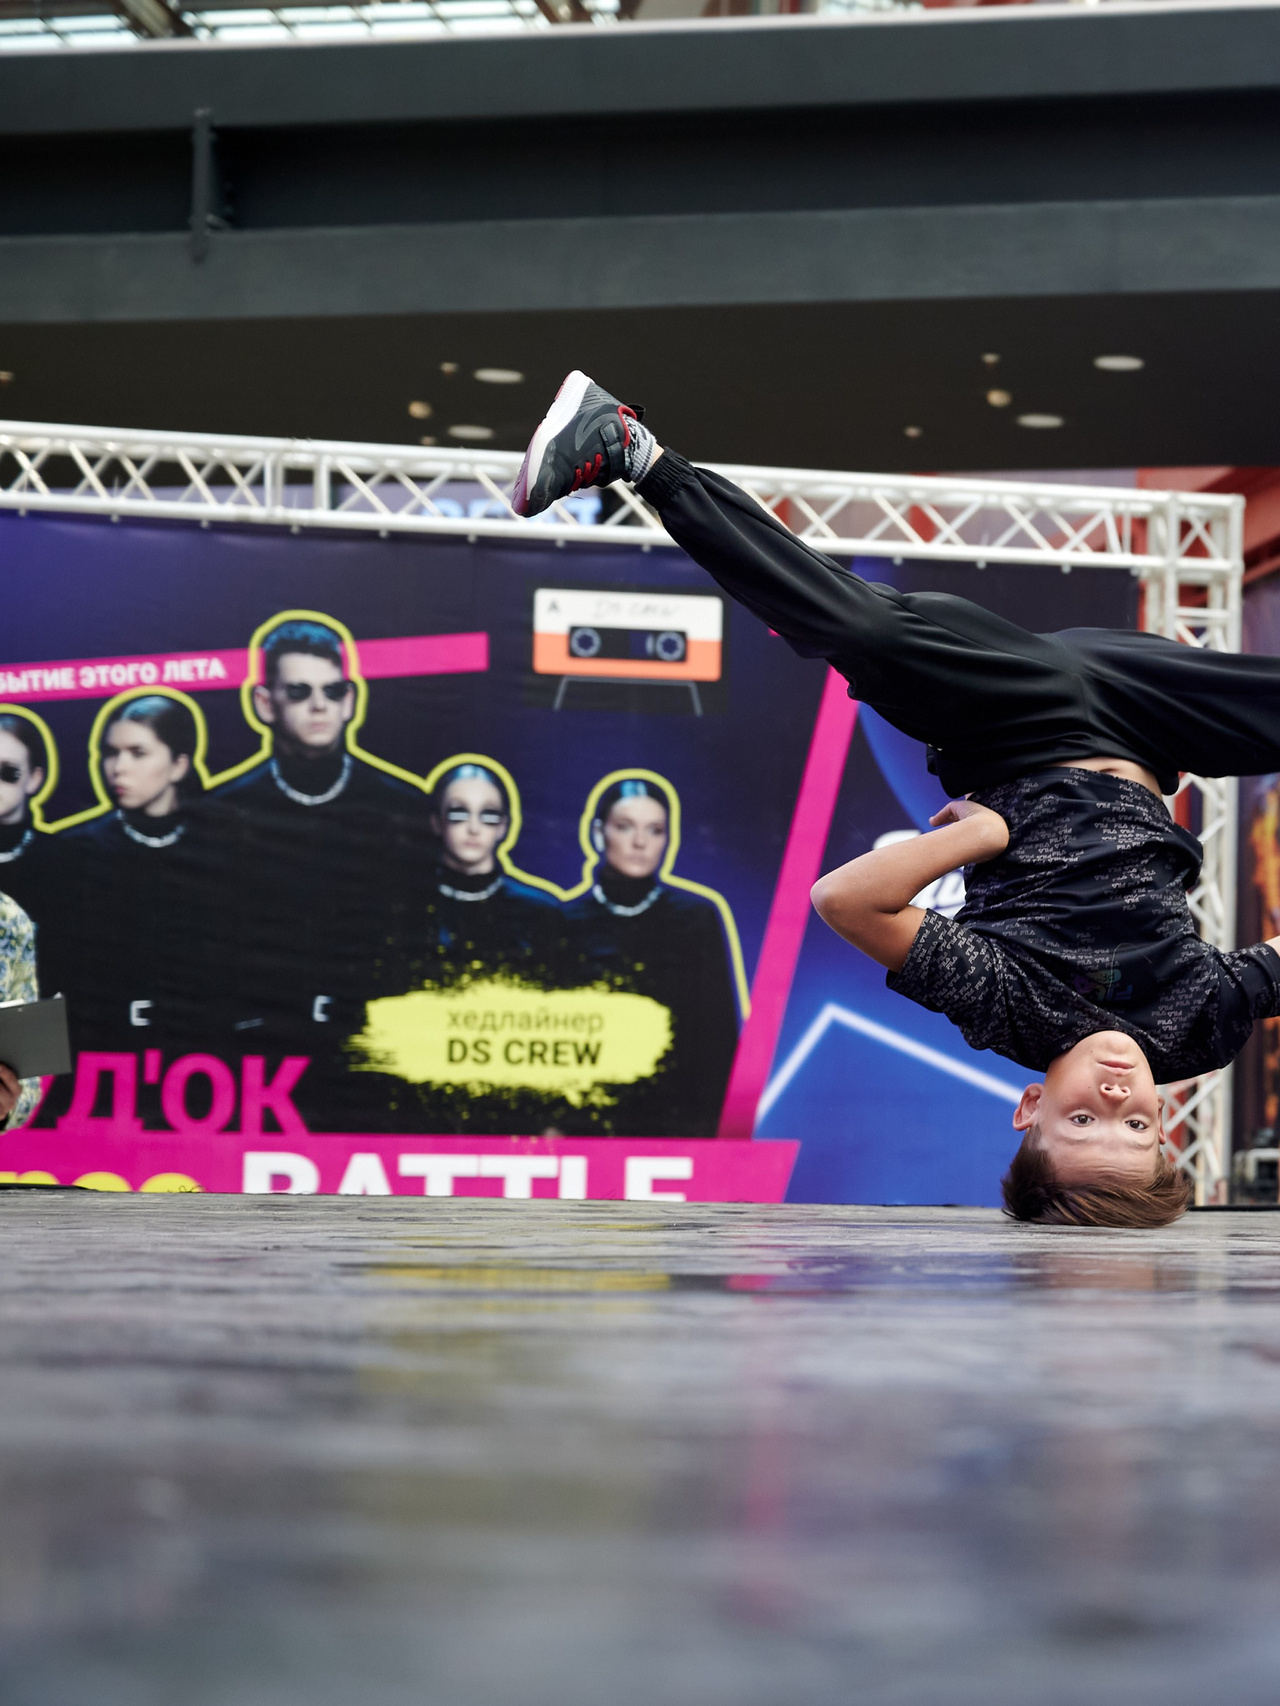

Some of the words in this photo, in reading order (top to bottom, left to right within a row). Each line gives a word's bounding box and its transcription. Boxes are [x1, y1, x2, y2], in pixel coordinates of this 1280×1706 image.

[79, 662, 158, 689] ЭТОГО
[162, 657, 227, 683] ЛЕТА
[447, 1006, 604, 1036] хедлайнер
[447, 1038, 491, 1065] DS
[503, 1039, 602, 1067] CREW
